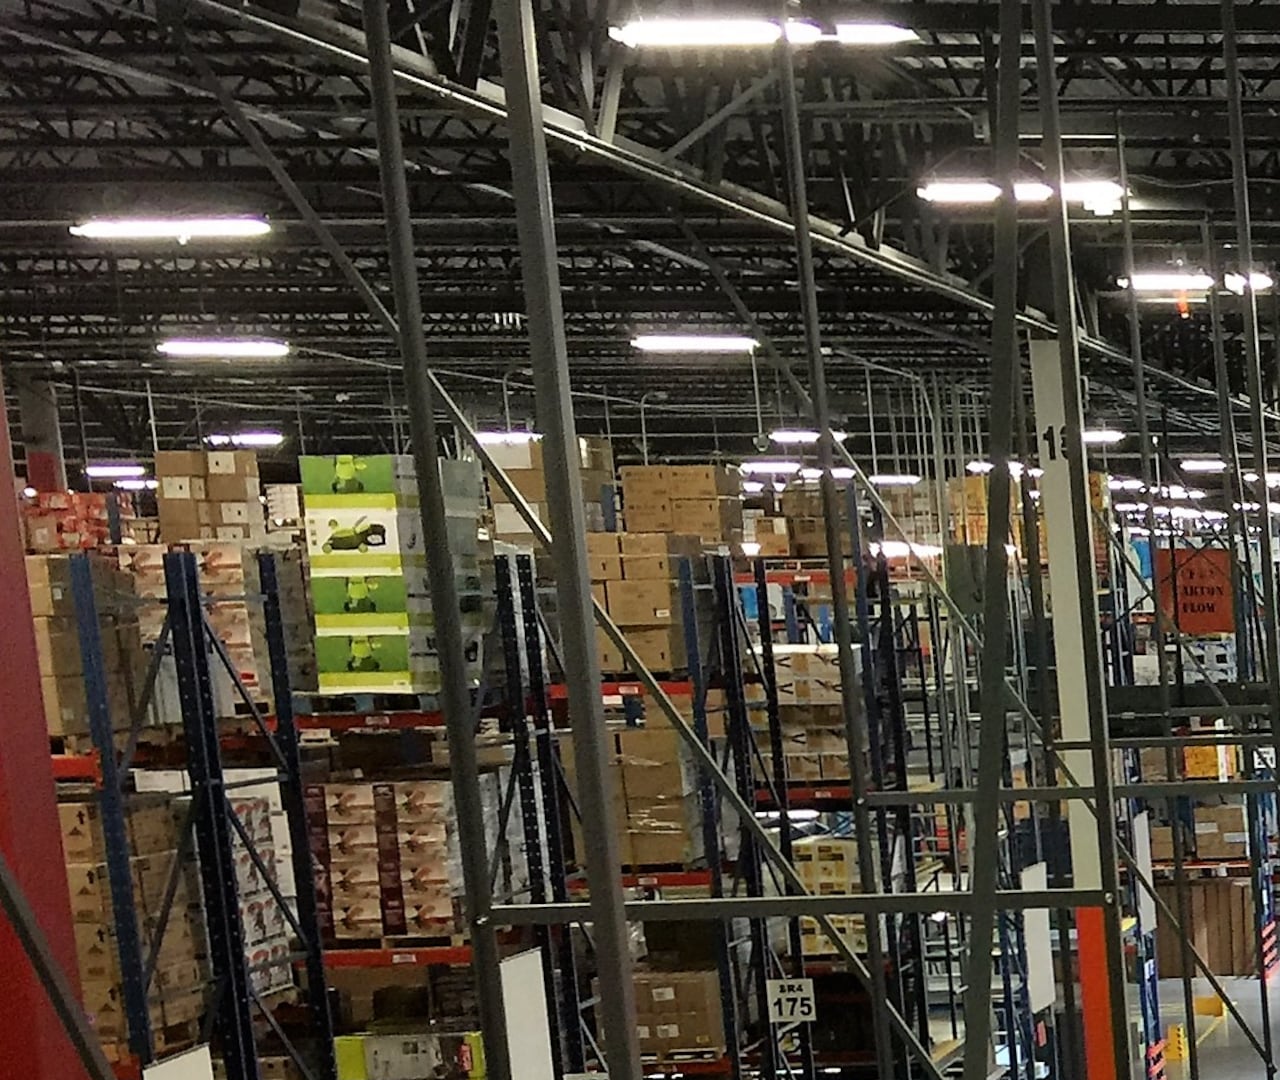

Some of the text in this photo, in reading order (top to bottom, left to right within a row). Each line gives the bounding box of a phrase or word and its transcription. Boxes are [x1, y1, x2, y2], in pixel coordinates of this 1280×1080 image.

[1042, 426, 1068, 460] 1
[779, 984, 803, 993] SR4
[773, 996, 812, 1016] 175
